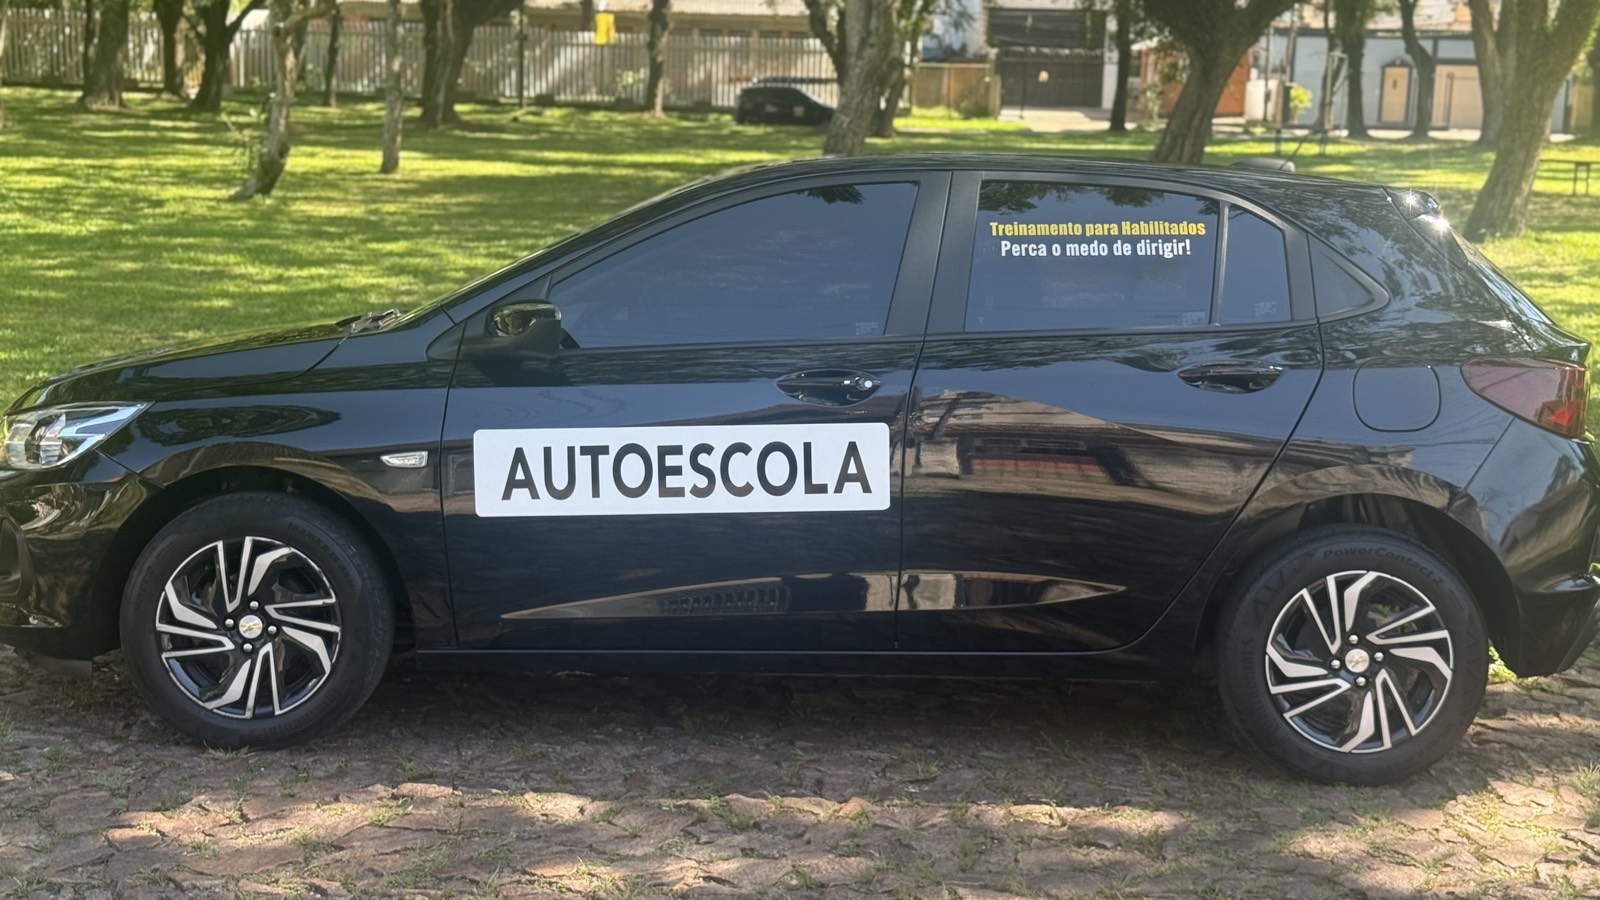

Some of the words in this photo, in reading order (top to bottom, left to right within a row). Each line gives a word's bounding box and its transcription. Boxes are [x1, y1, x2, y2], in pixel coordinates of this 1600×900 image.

[990, 222, 1082, 236] Treinamento
[1085, 222, 1119, 237] para
[1121, 221, 1206, 236] Habilitados
[1001, 240, 1048, 257] Perca
[1051, 245, 1062, 257] o
[1066, 240, 1109, 257] medo
[1113, 240, 1133, 256] de
[1136, 238, 1192, 258] dirigir!
[501, 441, 873, 501] AUTOESCOLA
[1322, 547, 1434, 577] PowerContact
